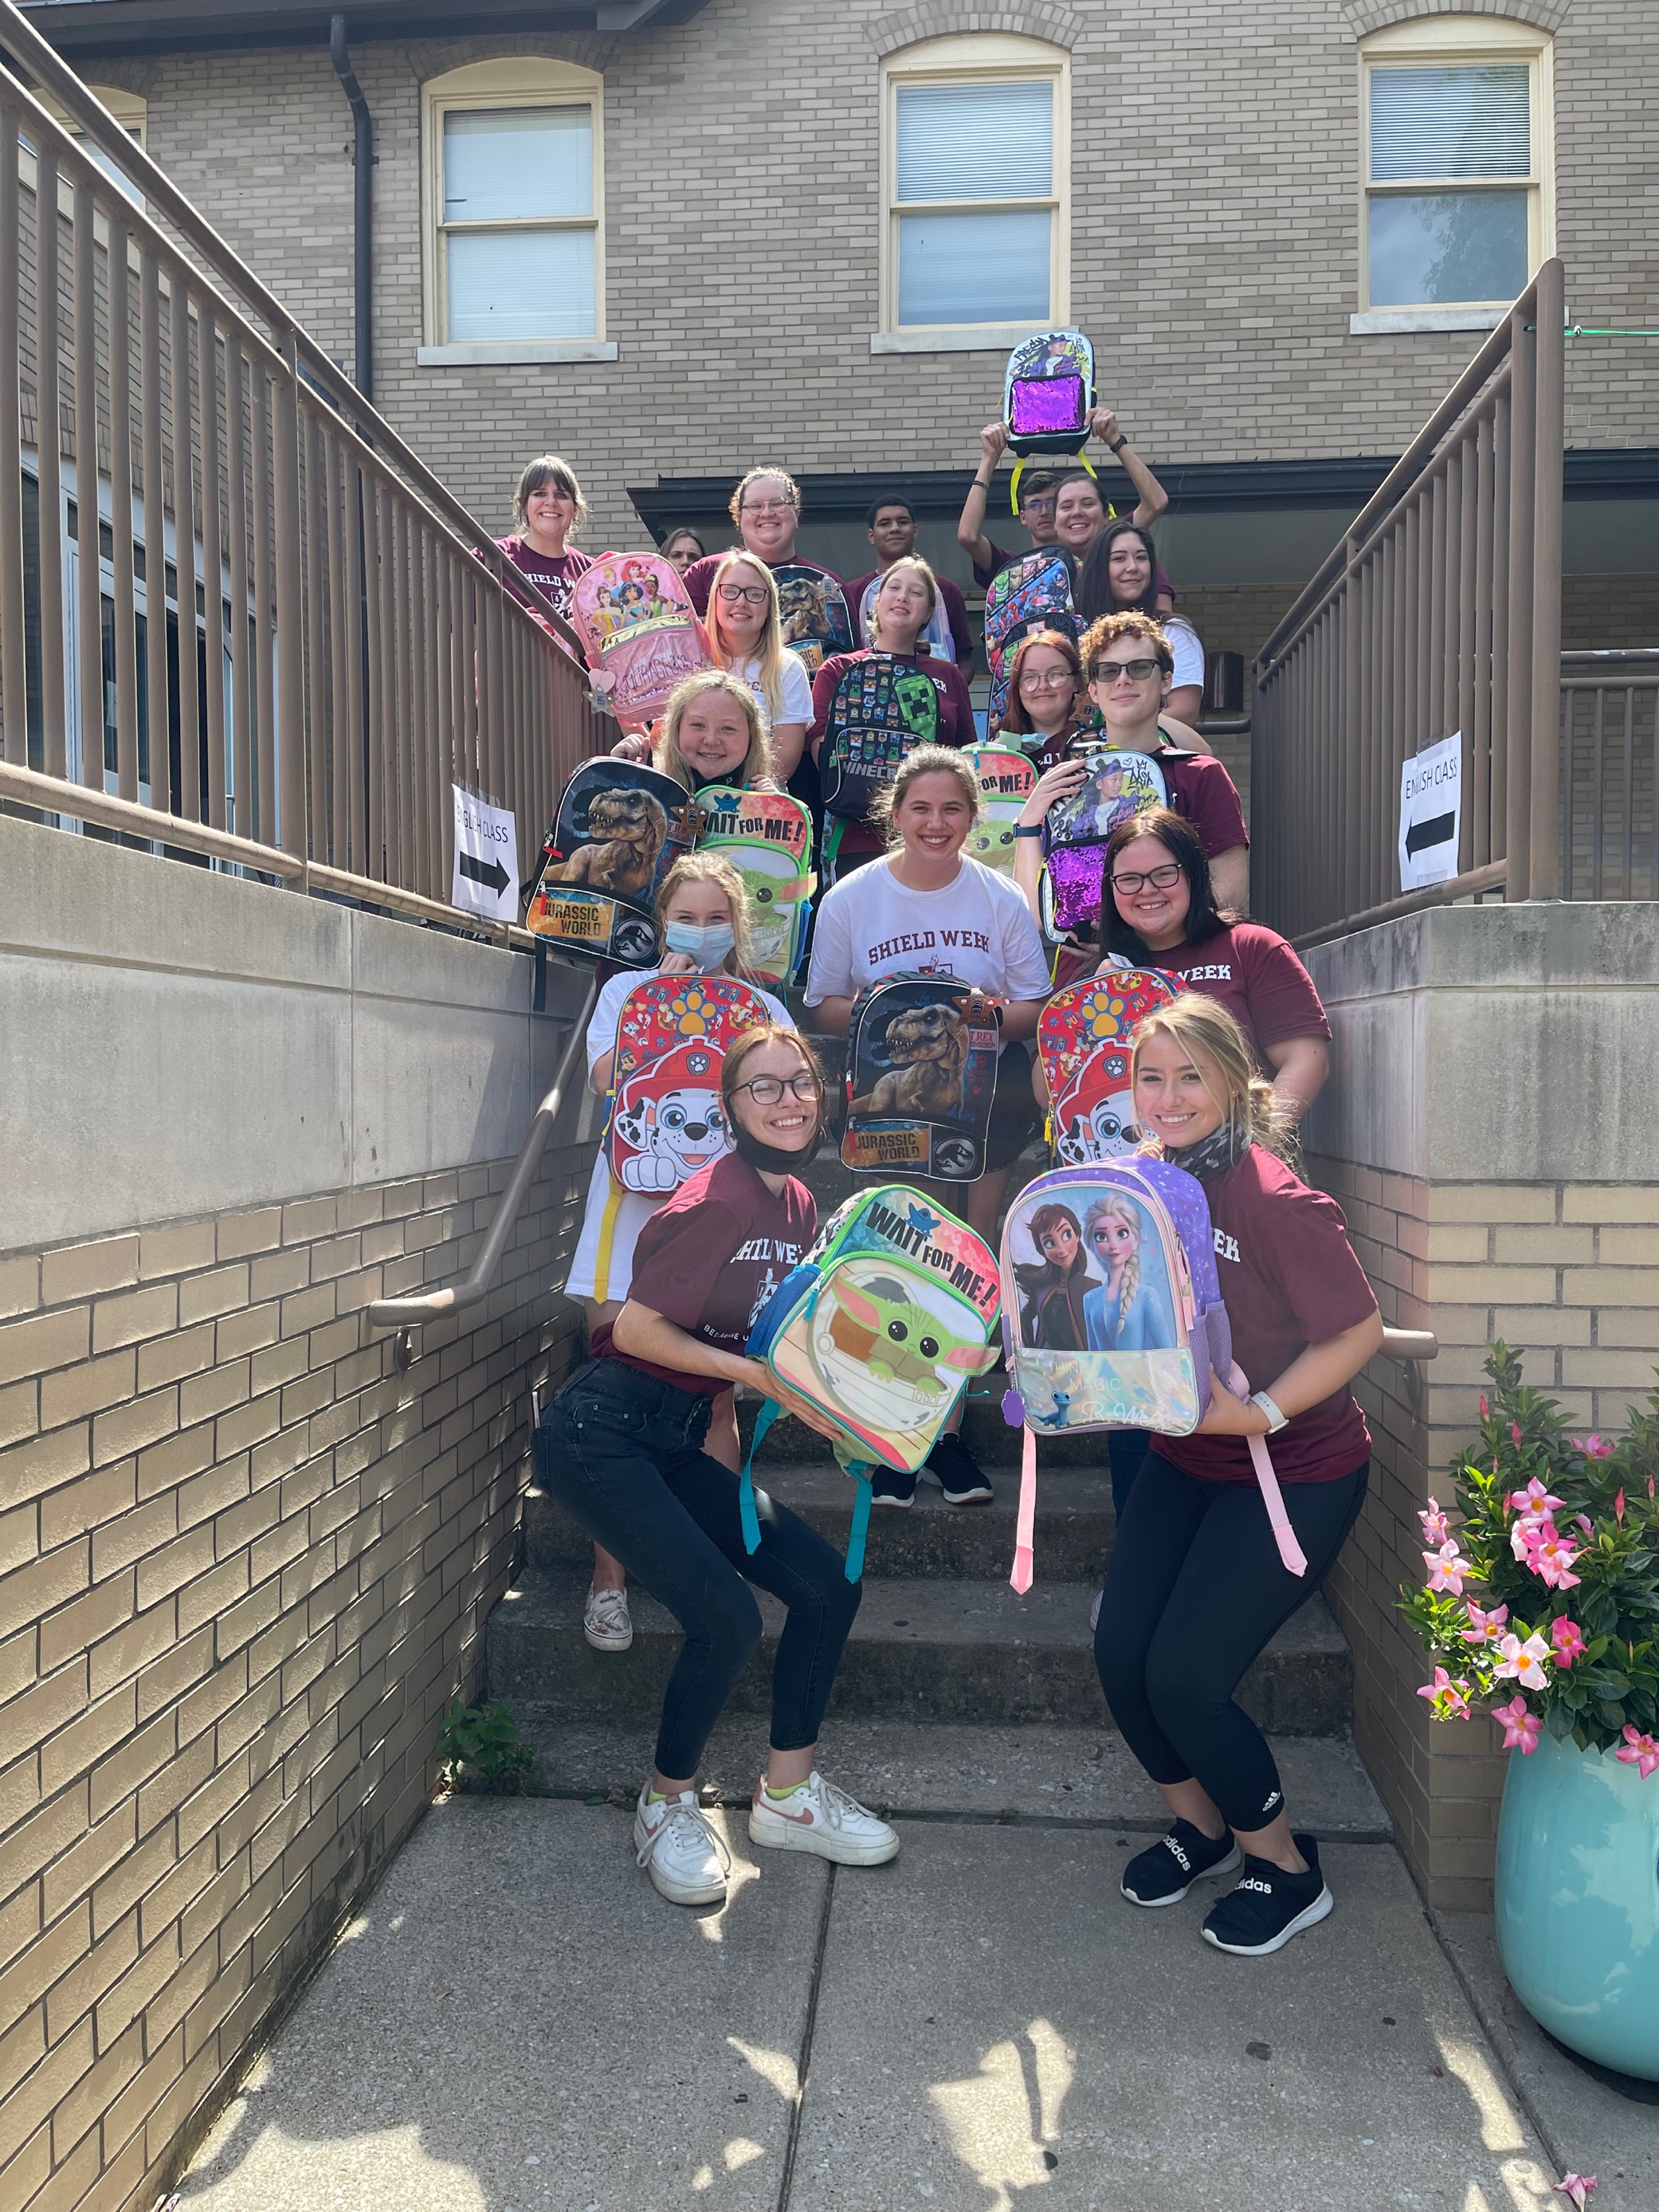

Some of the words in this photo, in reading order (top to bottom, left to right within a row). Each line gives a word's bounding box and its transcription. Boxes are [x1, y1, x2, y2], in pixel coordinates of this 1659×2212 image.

[524, 573, 562, 586] HIELD
[980, 775, 998, 791] OR
[457, 805, 482, 835] ENGLSH
[483, 820, 508, 843] CLASS
[706, 812, 739, 835] AIT
[739, 817, 763, 835] FOR
[764, 818, 804, 842] ME!
[561, 919, 602, 937] WORLD
[868, 931, 936, 966] SHIELD
[939, 930, 990, 954] WEEK
[857, 1133, 916, 1150] JURASSIC
[877, 1146, 920, 1161] WORLD
[865, 1201, 932, 1257] WAIT
[1213, 1228, 1241, 1263] EK
[922, 1245, 955, 1273] FOR
[948, 1261, 998, 1308] ME!
[1049, 1360, 1089, 1375] THINK
[1235, 1877, 1273, 1895] didas
